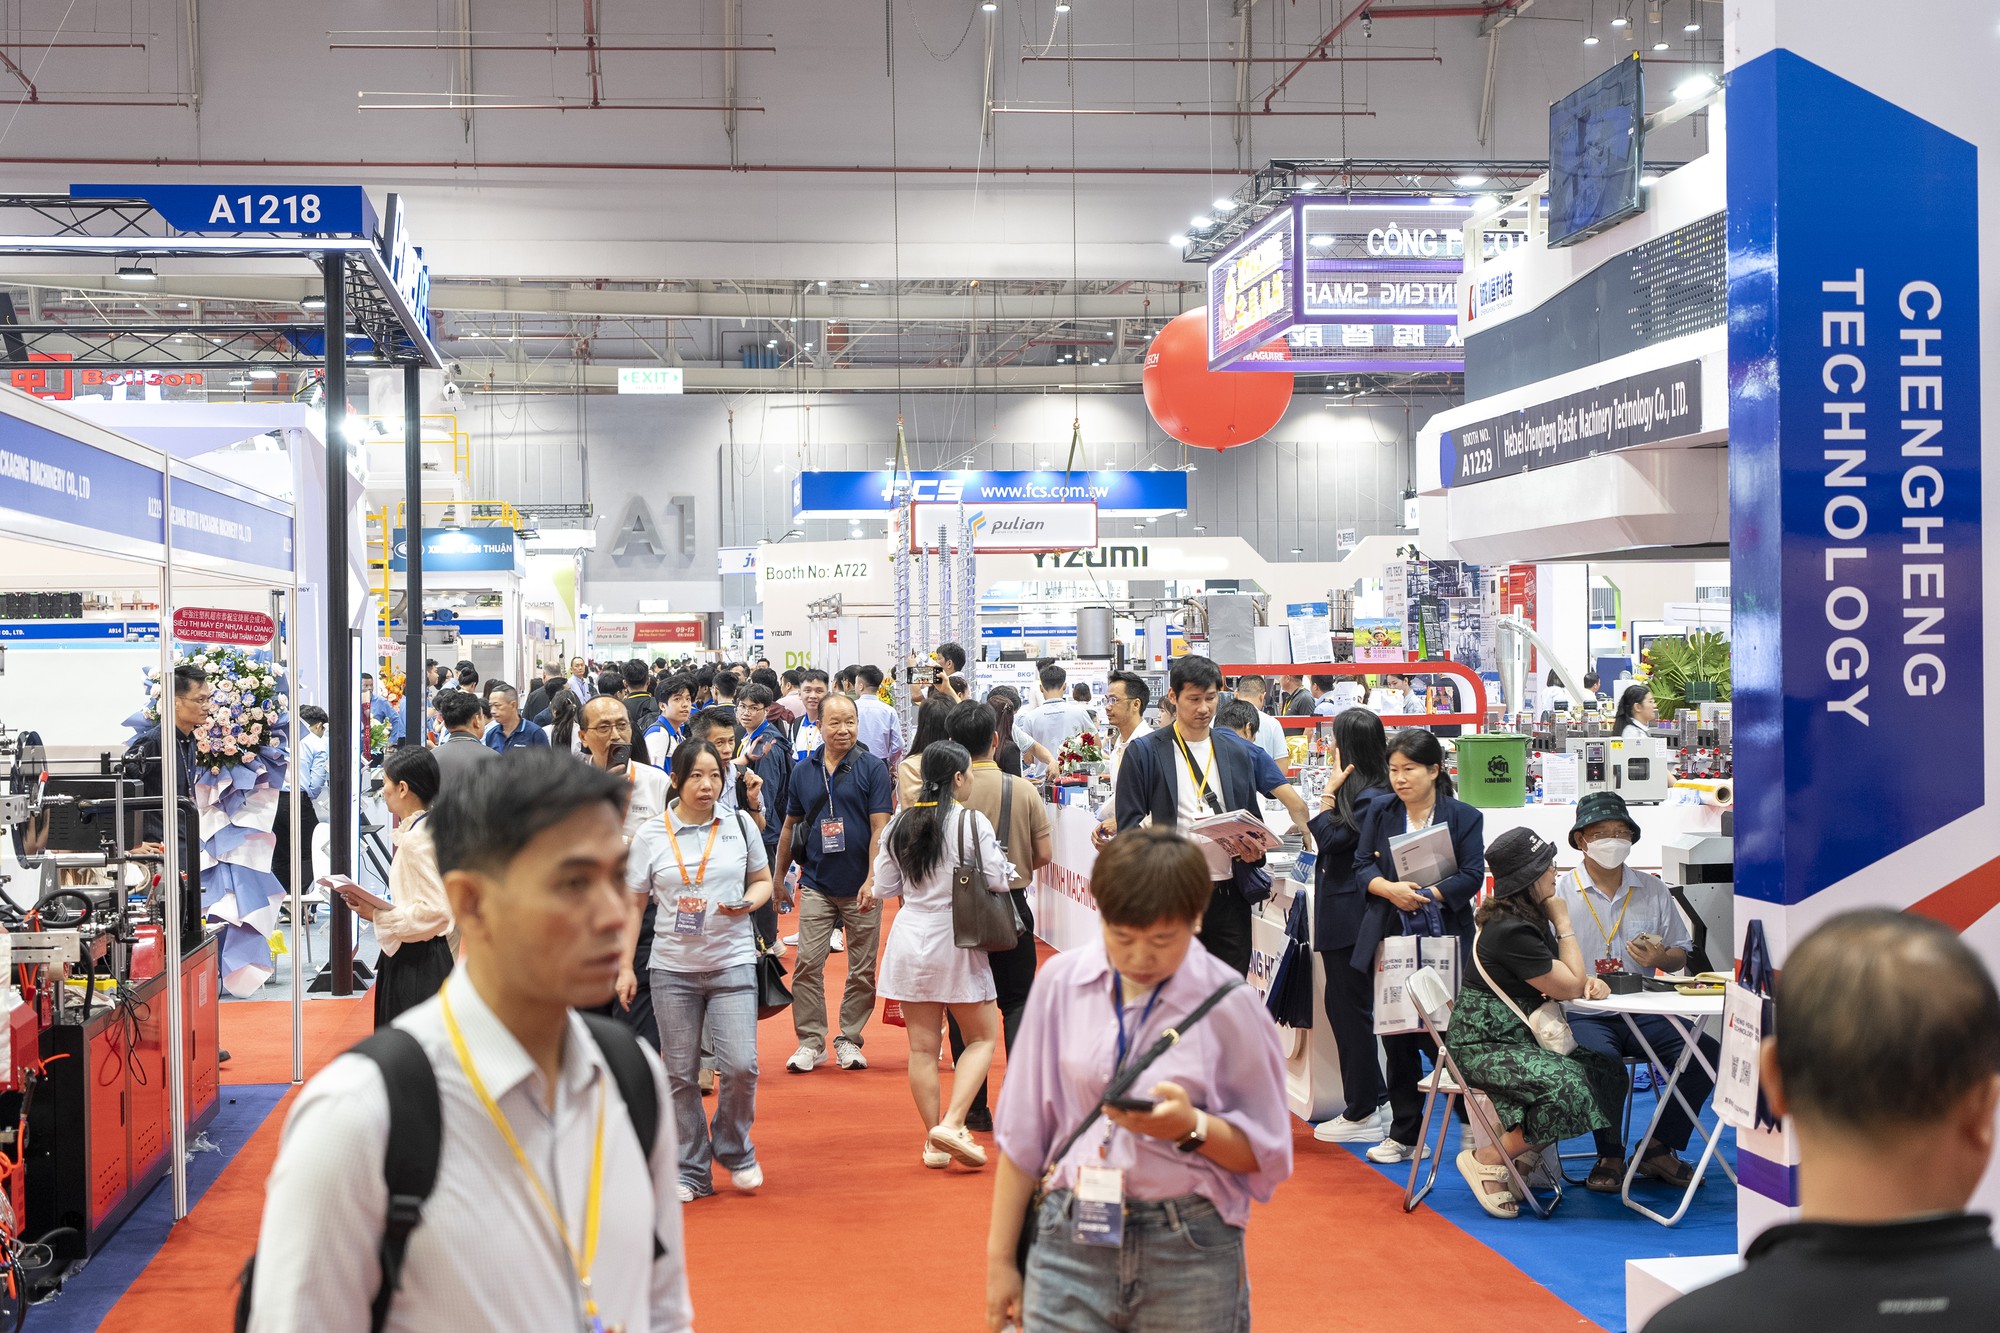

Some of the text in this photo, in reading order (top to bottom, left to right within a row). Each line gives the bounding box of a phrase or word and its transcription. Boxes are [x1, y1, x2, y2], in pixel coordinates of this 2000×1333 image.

[208, 193, 322, 224] A1218
[1367, 221, 1438, 256] CÔNG
[631, 371, 670, 383] EXIT
[1503, 421, 1524, 458] Hebei
[1579, 400, 1613, 440] Machinery
[1613, 389, 1654, 432] Technology
[1654, 386, 1670, 424] Co.,
[1671, 381, 1689, 418] LTD.
[1462, 428, 1491, 447] BOOTH NO.
[1461, 447, 1493, 477] A1229
[0, 448, 30, 483] CKAGING
[29, 458, 66, 494] MACHINERY
[79, 475, 91, 500] LTD
[880, 479, 966, 502] FCS
[980, 482, 1110, 499] www.fcs.com.tw
[1821, 267, 1870, 727] TECHNOLOGY
[1898, 279, 1947, 697] CHENGHENG
[610, 494, 697, 560] A1
[990, 516, 1045, 535] pulian
[483, 543, 513, 555] THUẬN
[766, 563, 868, 580] Booth No: A722
[190, 629, 215, 638] POWERJET
[253, 625, 274, 633] QIANG
